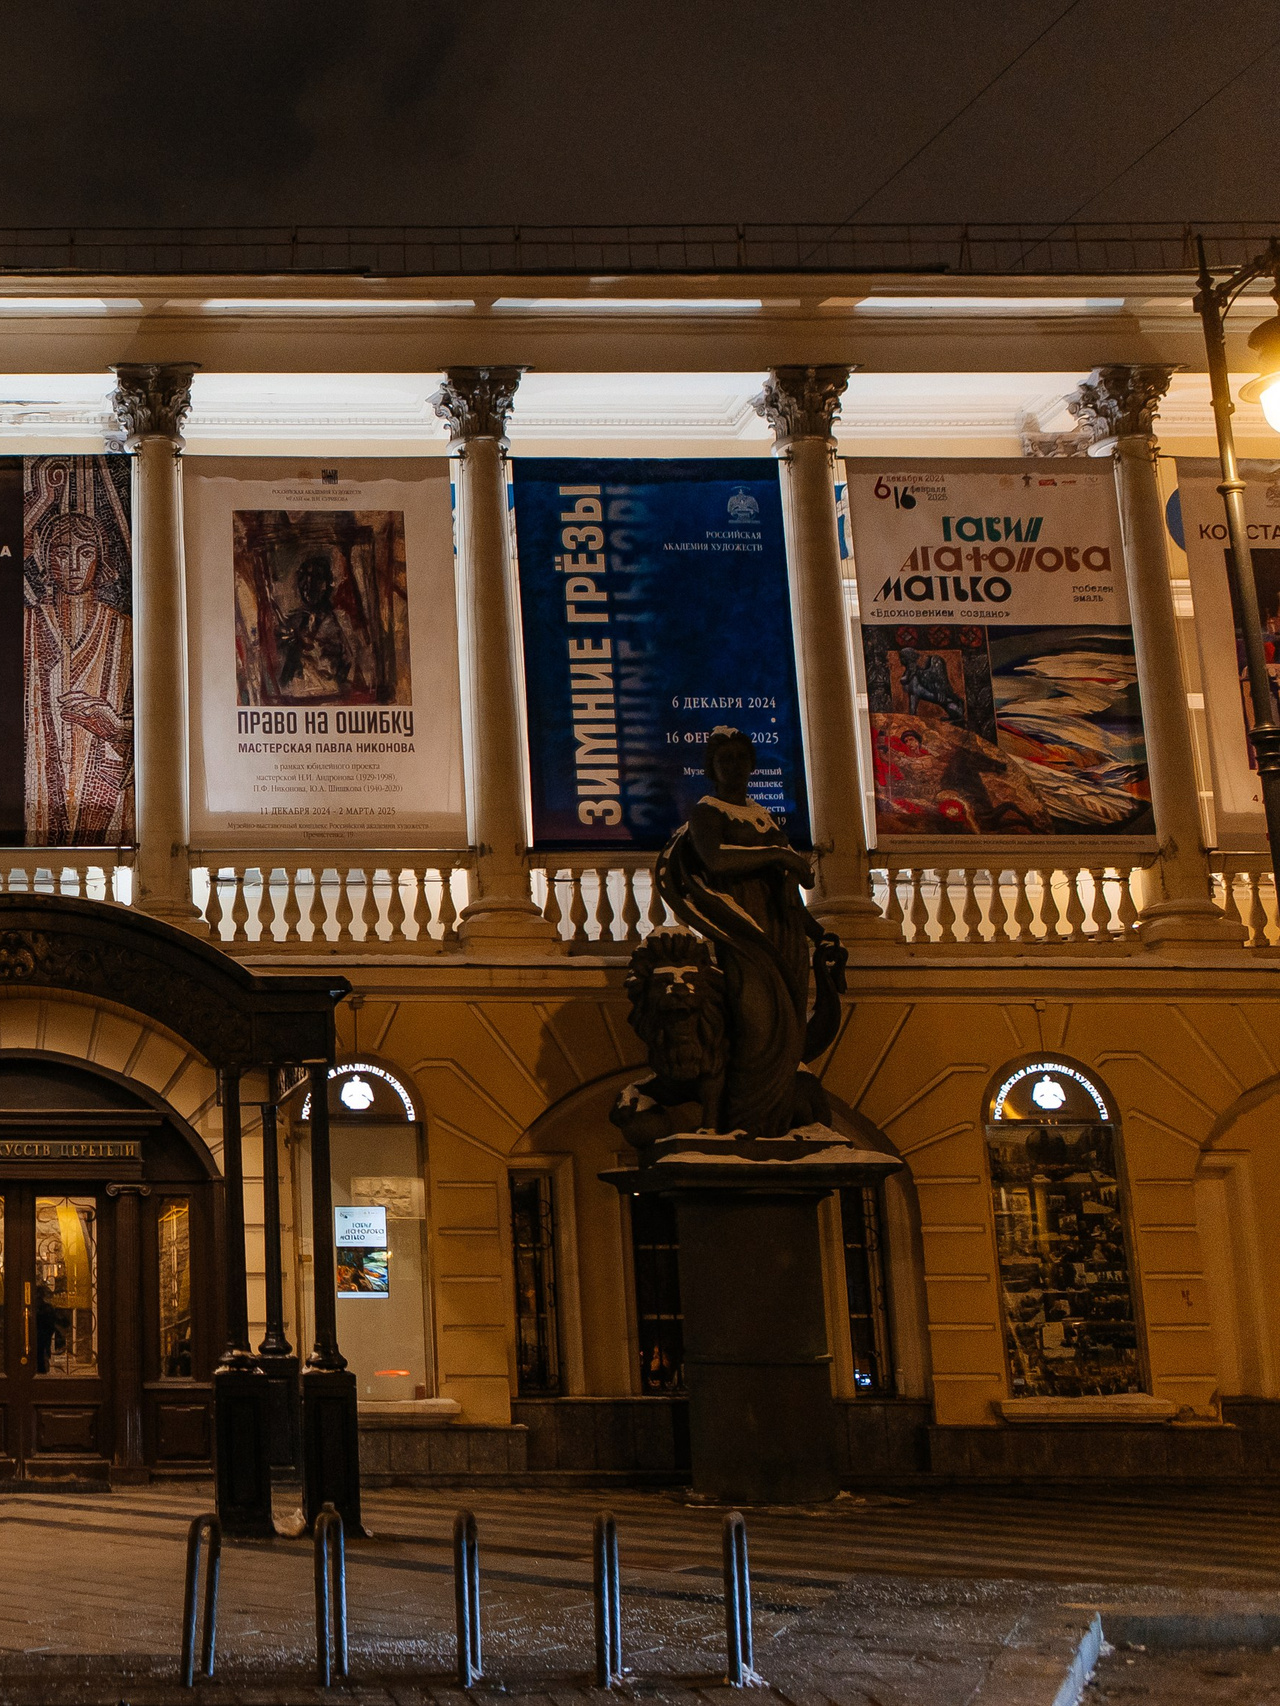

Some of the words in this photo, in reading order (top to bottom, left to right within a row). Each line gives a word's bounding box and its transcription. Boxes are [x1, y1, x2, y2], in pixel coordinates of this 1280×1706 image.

[874, 476, 891, 499] 6
[886, 475, 923, 483] декабря
[894, 486, 916, 509] 16
[706, 530, 762, 539] РОССИЙСКАЯ
[663, 543, 709, 551] АКАДЕМИЯ
[711, 543, 763, 551] ХУДОЖЕСТВ
[554, 485, 610, 623] ГРЁЗЫ
[1072, 585, 1114, 593] гобелен
[1073, 594, 1104, 602] эмаль
[870, 609, 954, 618] «Вдохновением
[960, 609, 1010, 618] создано»
[672, 696, 679, 708] 6
[683, 697, 743, 710] ДЕКАБРЯ
[747, 697, 776, 708] 2024
[568, 638, 623, 826] ЗИМНИЕ
[666, 731, 679, 743] 16
[751, 732, 779, 744] 2025
[238, 743, 312, 753] МАСТЕРСКАЯ
[315, 743, 353, 753] ПАВЛА
[356, 742, 415, 753] НИКОНОВА
[306, 762, 350, 771] юбилейного
[256, 773, 296, 782] мастерской
[315, 774, 354, 782] Андронова
[260, 807, 268, 815] 11
[271, 807, 310, 816] ДЕКАБРЯ
[312, 807, 331, 815] 2024
[339, 807, 343, 815] 2
[346, 807, 375, 815] МАРТА
[377, 807, 396, 815] 2025
[336, 1063, 385, 1077] АКАДЕМИЯ
[383, 1072, 416, 1122] ХУДОЖЕСТВ
[994, 1069, 1026, 1120] РОССИЙСКАЯ
[1026, 1063, 1075, 1077] АКАДЕМИЯ
[1073, 1072, 1109, 1121] ХУДОЖЕСТВ
[60, 1145, 135, 1156] ЦЕРЕТЕЛИ
